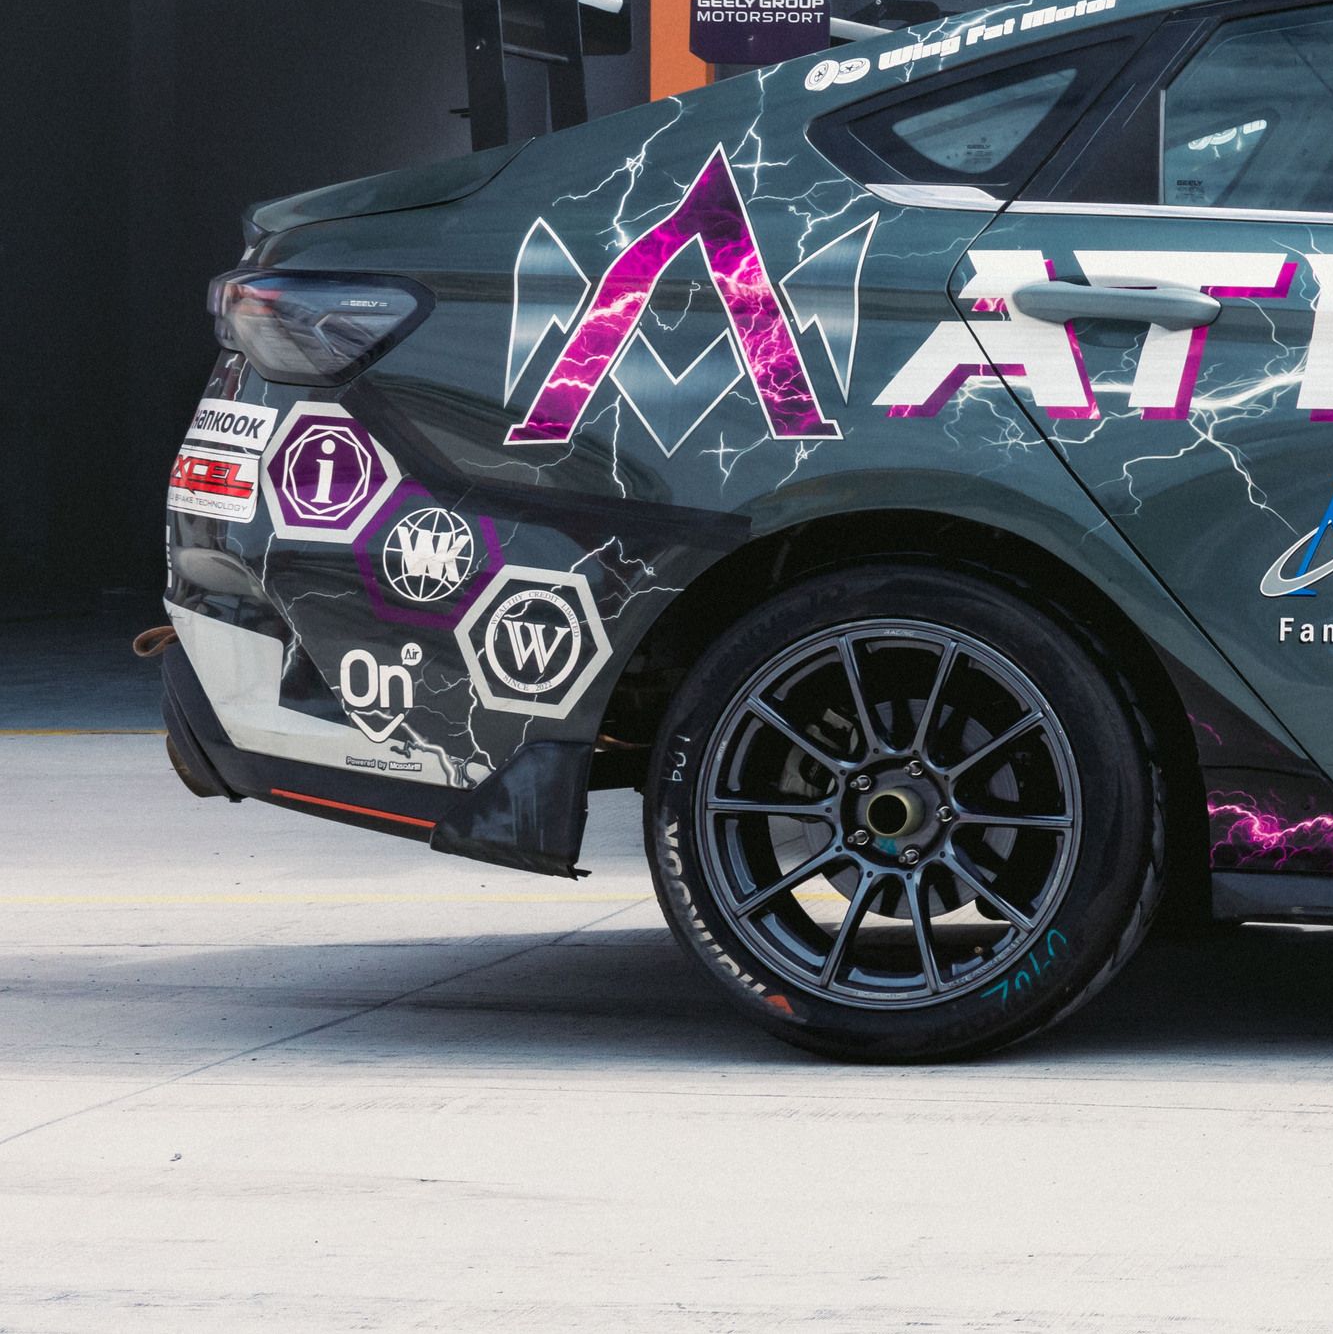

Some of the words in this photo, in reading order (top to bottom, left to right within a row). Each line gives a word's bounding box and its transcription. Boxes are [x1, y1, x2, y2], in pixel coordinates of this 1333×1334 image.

[696, 10, 825, 24] MOTORSPORT
[877, 34, 961, 70] Wing
[966, 18, 1016, 46] Fat
[340, 649, 414, 708] On
